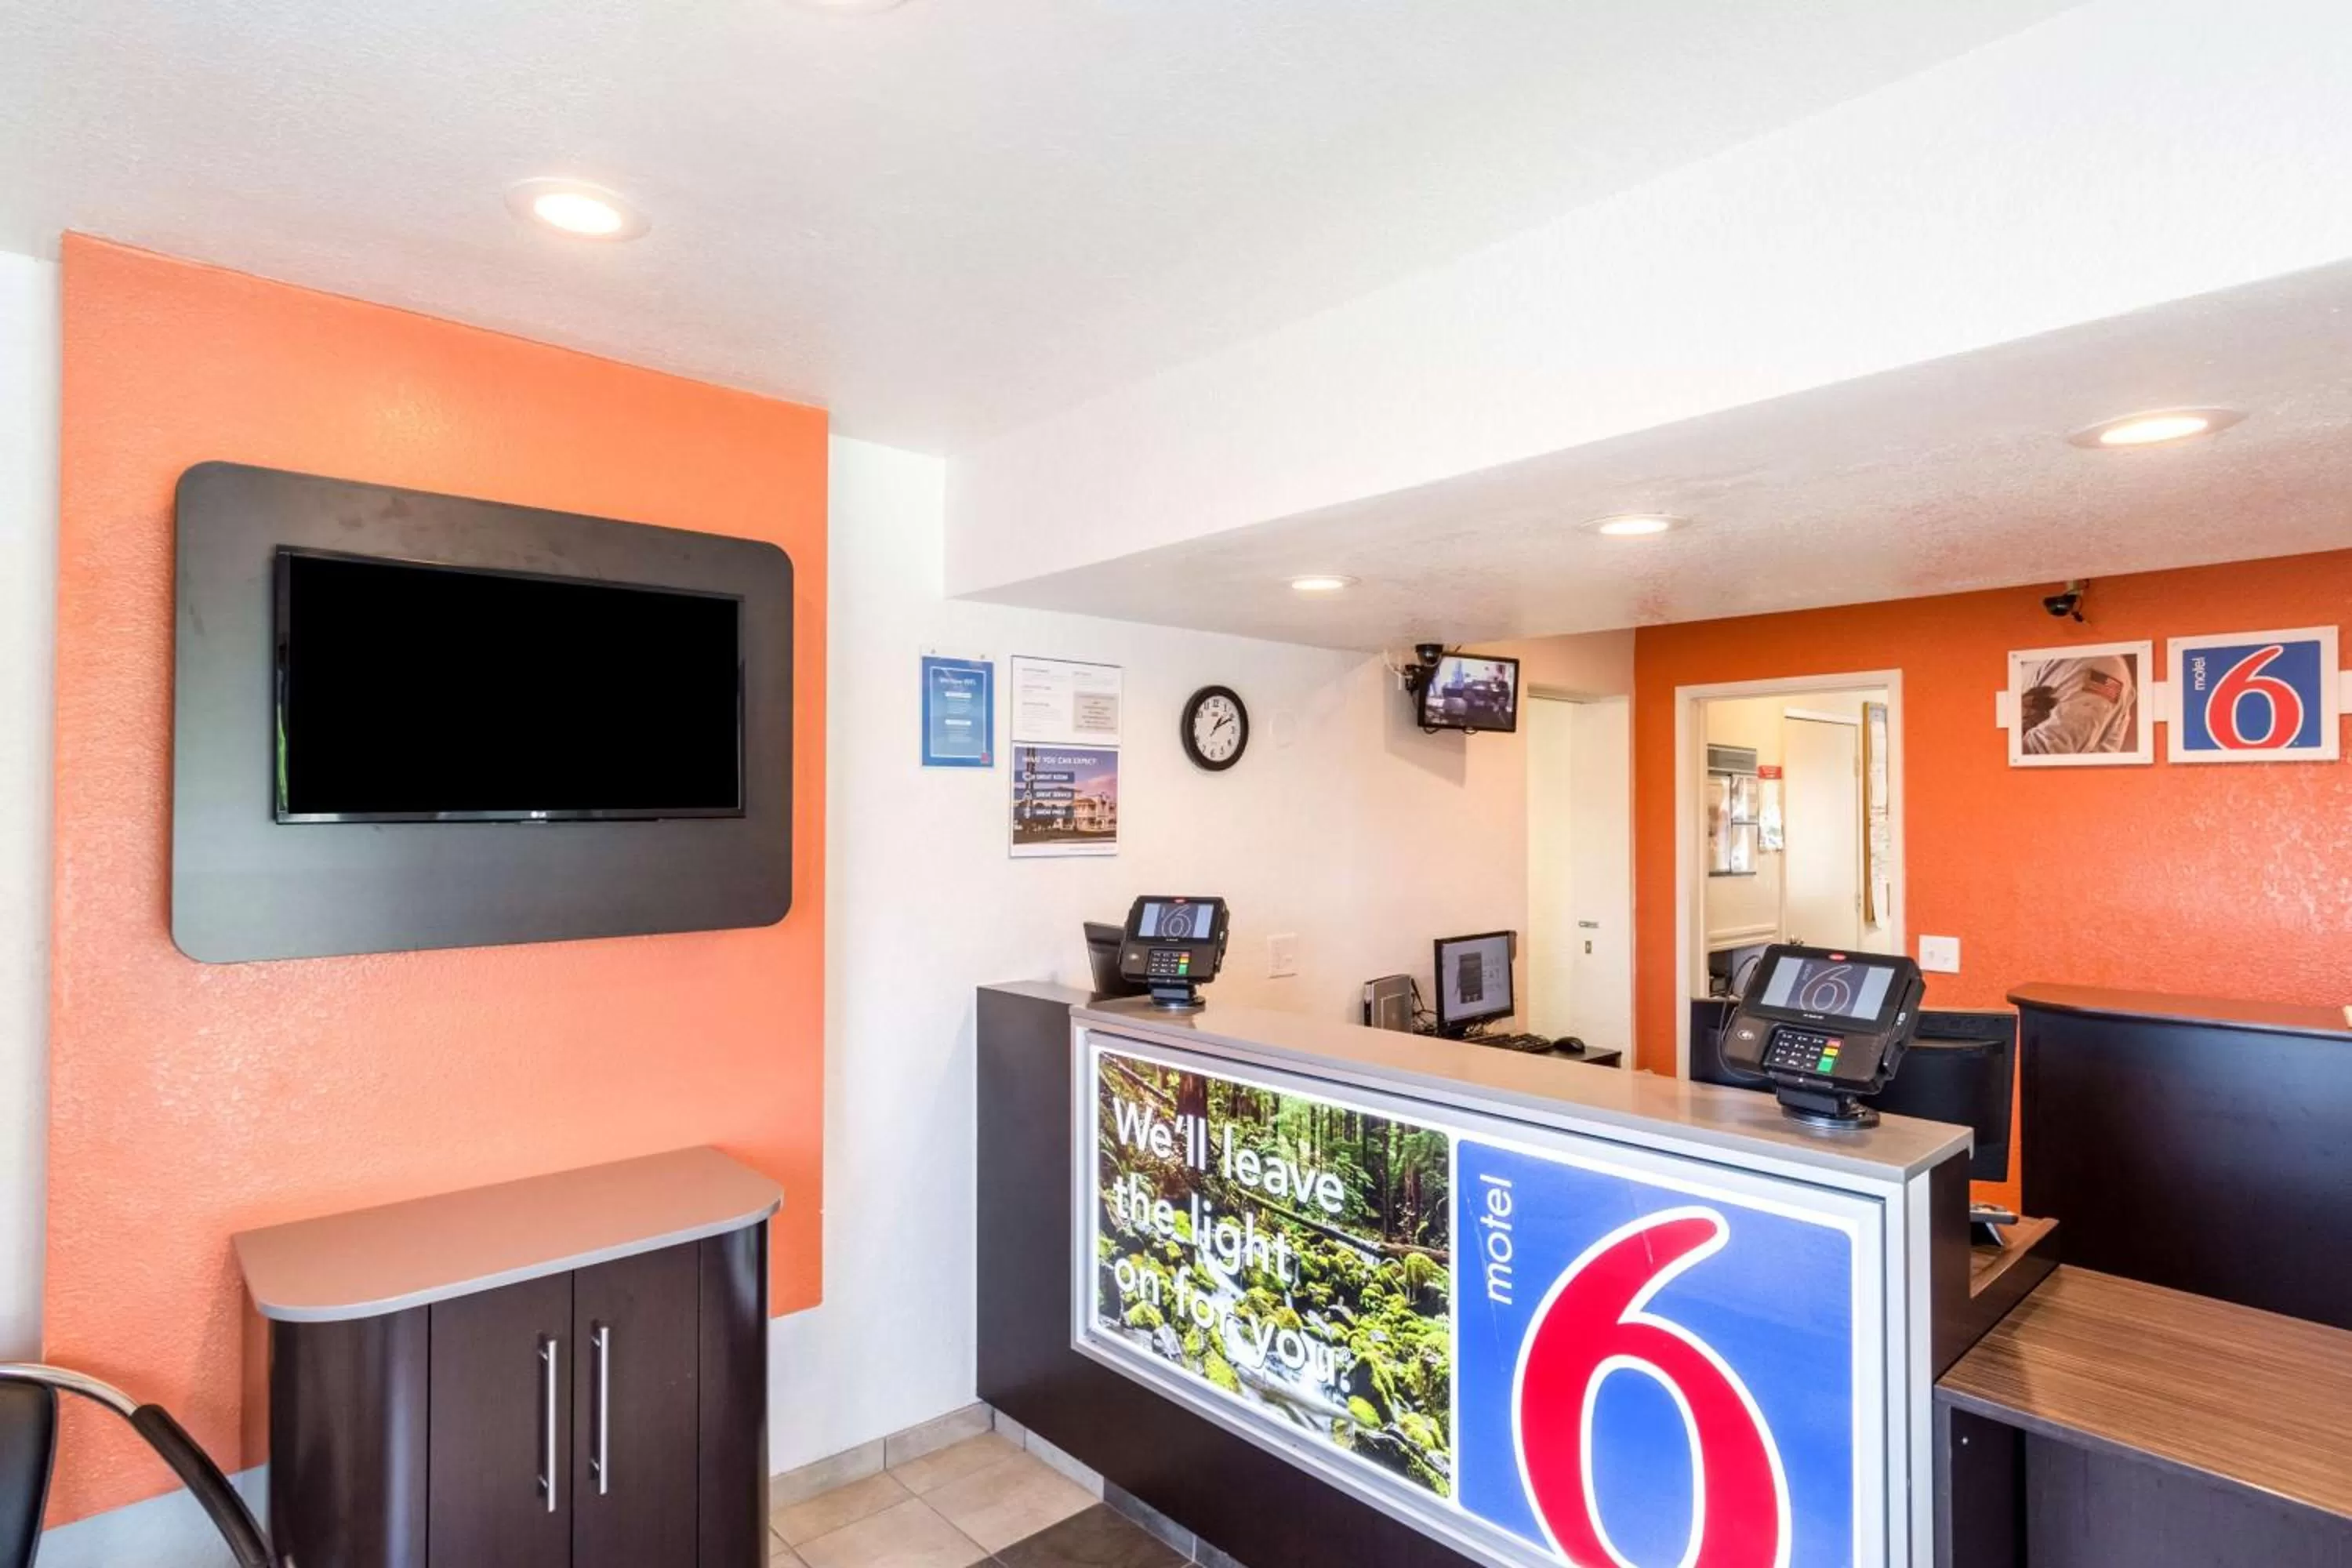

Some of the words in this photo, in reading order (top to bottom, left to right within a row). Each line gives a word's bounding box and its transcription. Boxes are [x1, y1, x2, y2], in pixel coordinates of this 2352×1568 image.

[2192, 656, 2205, 691] motel
[2205, 645, 2303, 750] 6
[1112, 1096, 1207, 1171] We'll
[1223, 1121, 1345, 1213] leave
[1112, 1175, 1174, 1236] the
[1189, 1192, 1294, 1280] light
[1114, 1256, 1160, 1306] on
[1174, 1265, 1232, 1338] for
[1479, 1174, 1512, 1305] motel
[1511, 1206, 1792, 1568] 6
